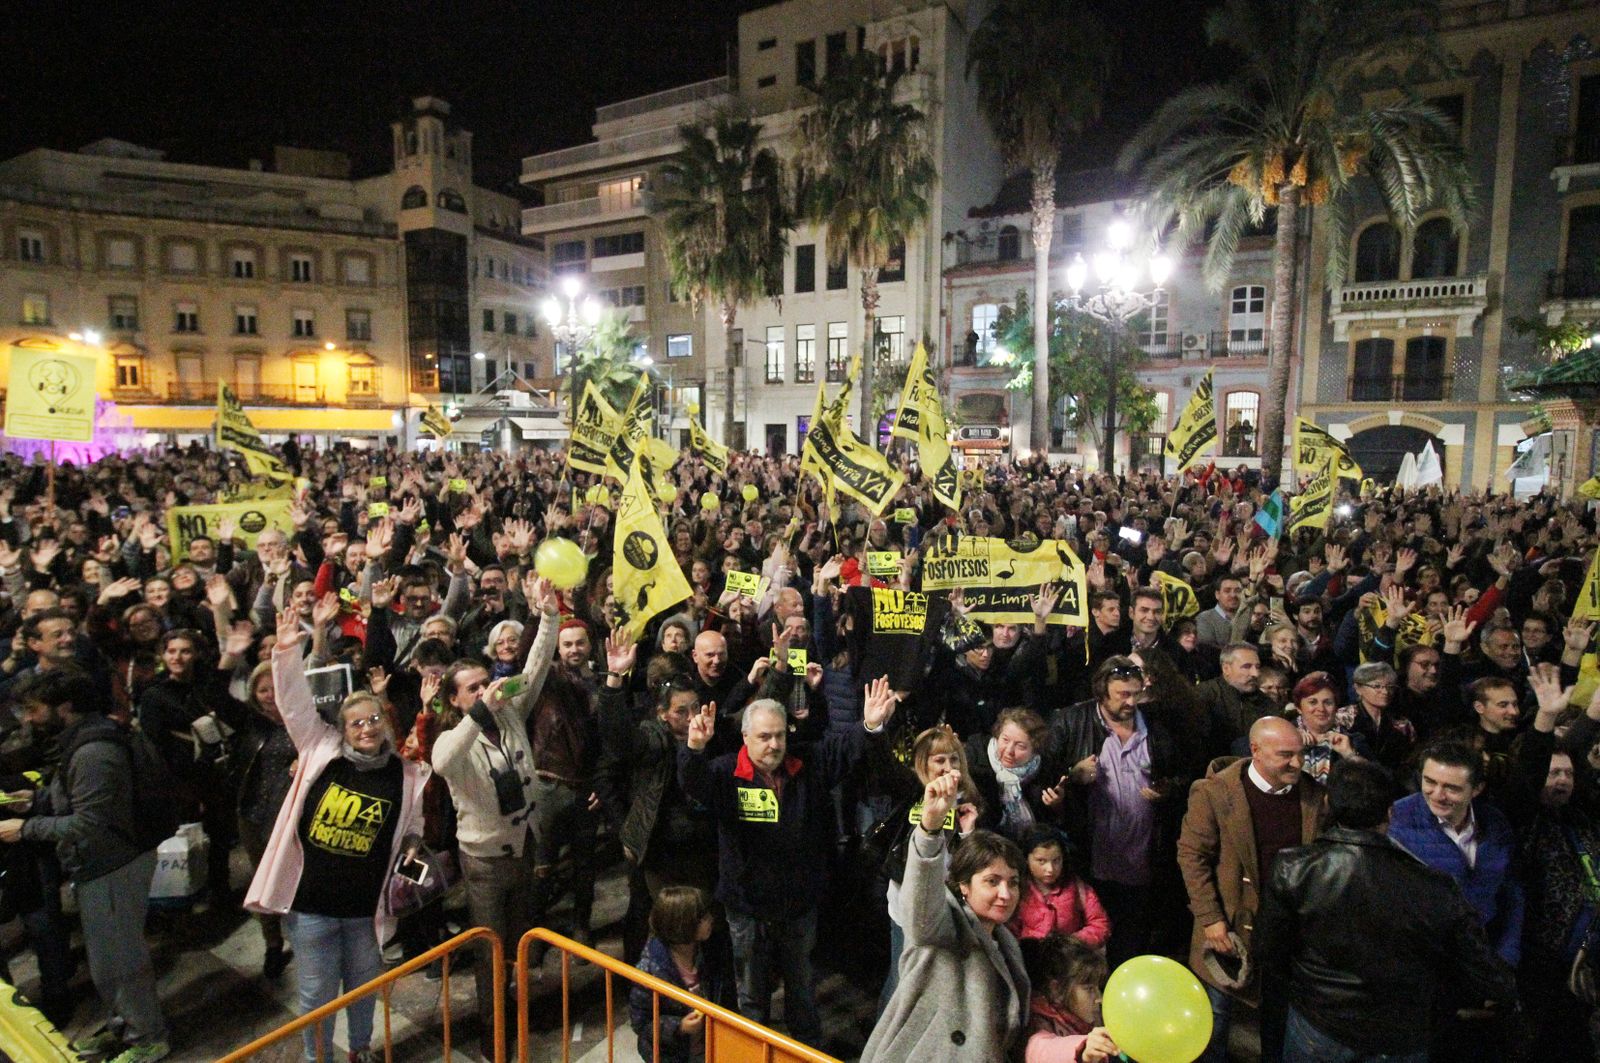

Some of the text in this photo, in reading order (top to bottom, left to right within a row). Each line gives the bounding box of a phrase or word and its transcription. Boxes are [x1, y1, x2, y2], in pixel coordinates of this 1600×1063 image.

[860, 472, 887, 499] YA
[177, 514, 207, 537] NO
[873, 586, 905, 613] NO
[875, 612, 926, 631] FOSFOYESOS
[319, 785, 362, 828] NO
[309, 819, 372, 852] FOSFOYESOS
